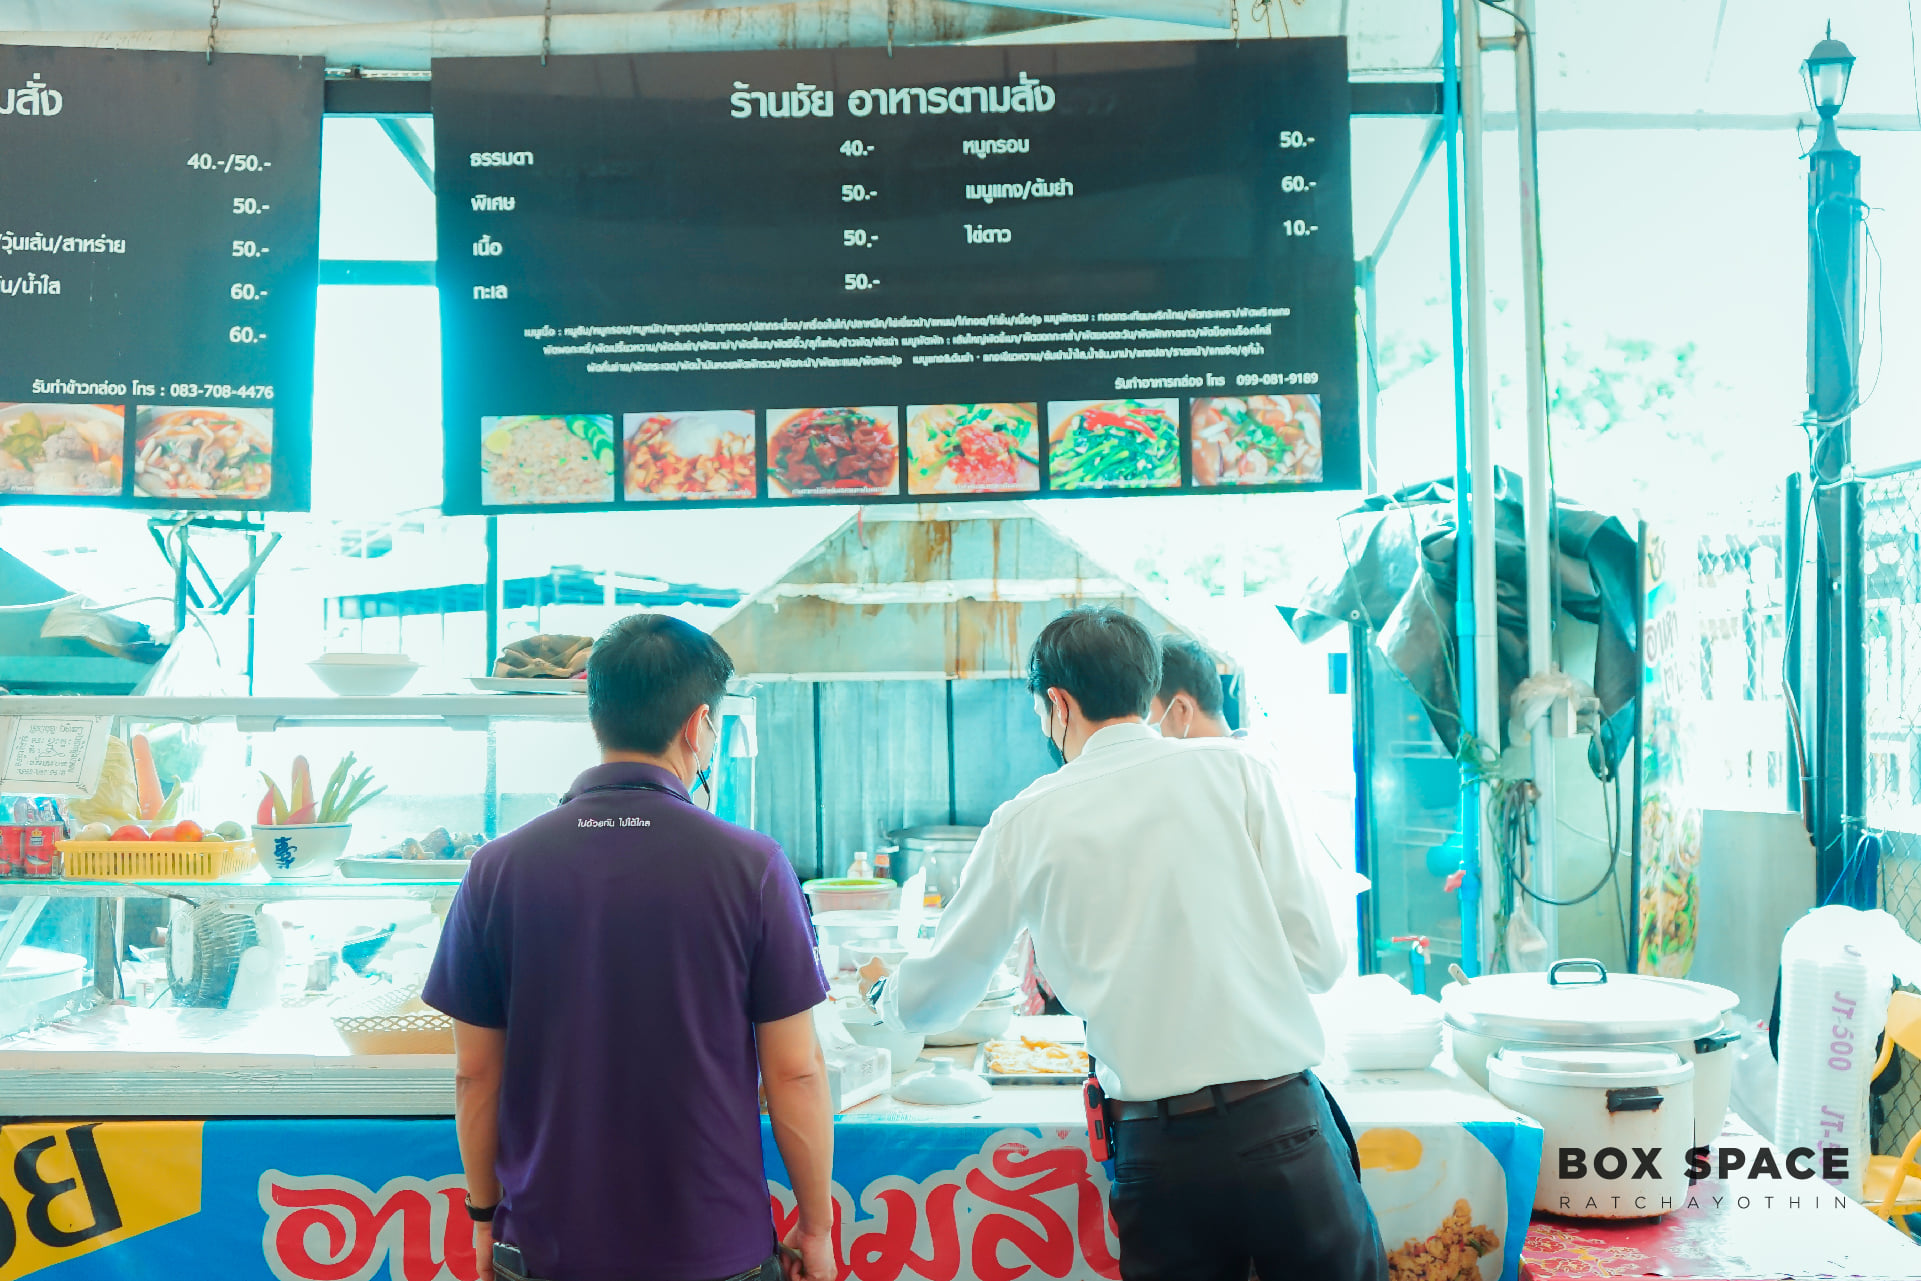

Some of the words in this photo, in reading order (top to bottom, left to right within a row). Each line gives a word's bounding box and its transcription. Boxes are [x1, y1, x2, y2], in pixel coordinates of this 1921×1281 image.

[731, 81, 833, 118] ร้านชัย
[848, 72, 1055, 116] อาหารตามสั่ง
[1281, 131, 1315, 147] 50.-
[840, 140, 874, 156] 40.-
[963, 139, 1029, 159] หมูกรอบ
[187, 153, 271, 173] 40.-/50.-
[470, 152, 533, 166] ธรรมดา
[966, 178, 1073, 204] เมนูแกง/ต้มยำ
[1282, 176, 1316, 192] 60.-
[842, 185, 877, 201] 50.-
[233, 198, 269, 214] 50.-
[471, 195, 515, 211] พิเศษ
[964, 224, 1011, 243] ไข่ดาว
[1284, 220, 1318, 236] 10.-
[473, 235, 502, 256] เนื้อ
[844, 230, 878, 247] 50.-
[232, 241, 269, 257] 50.-
[845, 274, 880, 290] 50.-
[231, 283, 267, 300] 60.-
[473, 285, 507, 299] ทะเล
[230, 326, 266, 343] 60.-
[1114, 373, 1204, 390] รับทำอาหารกล่อง
[1205, 372, 1226, 387] โทร
[1235, 371, 1319, 386] 099-081-9189
[33, 379, 126, 395] รับทำข้าวกล่อง
[133, 380, 155, 396] โทร
[170, 384, 274, 399] 083-708-4476
[577, 818, 615, 828] ไปด้วยกัน
[618, 817, 651, 827] ไปได้ไกล
